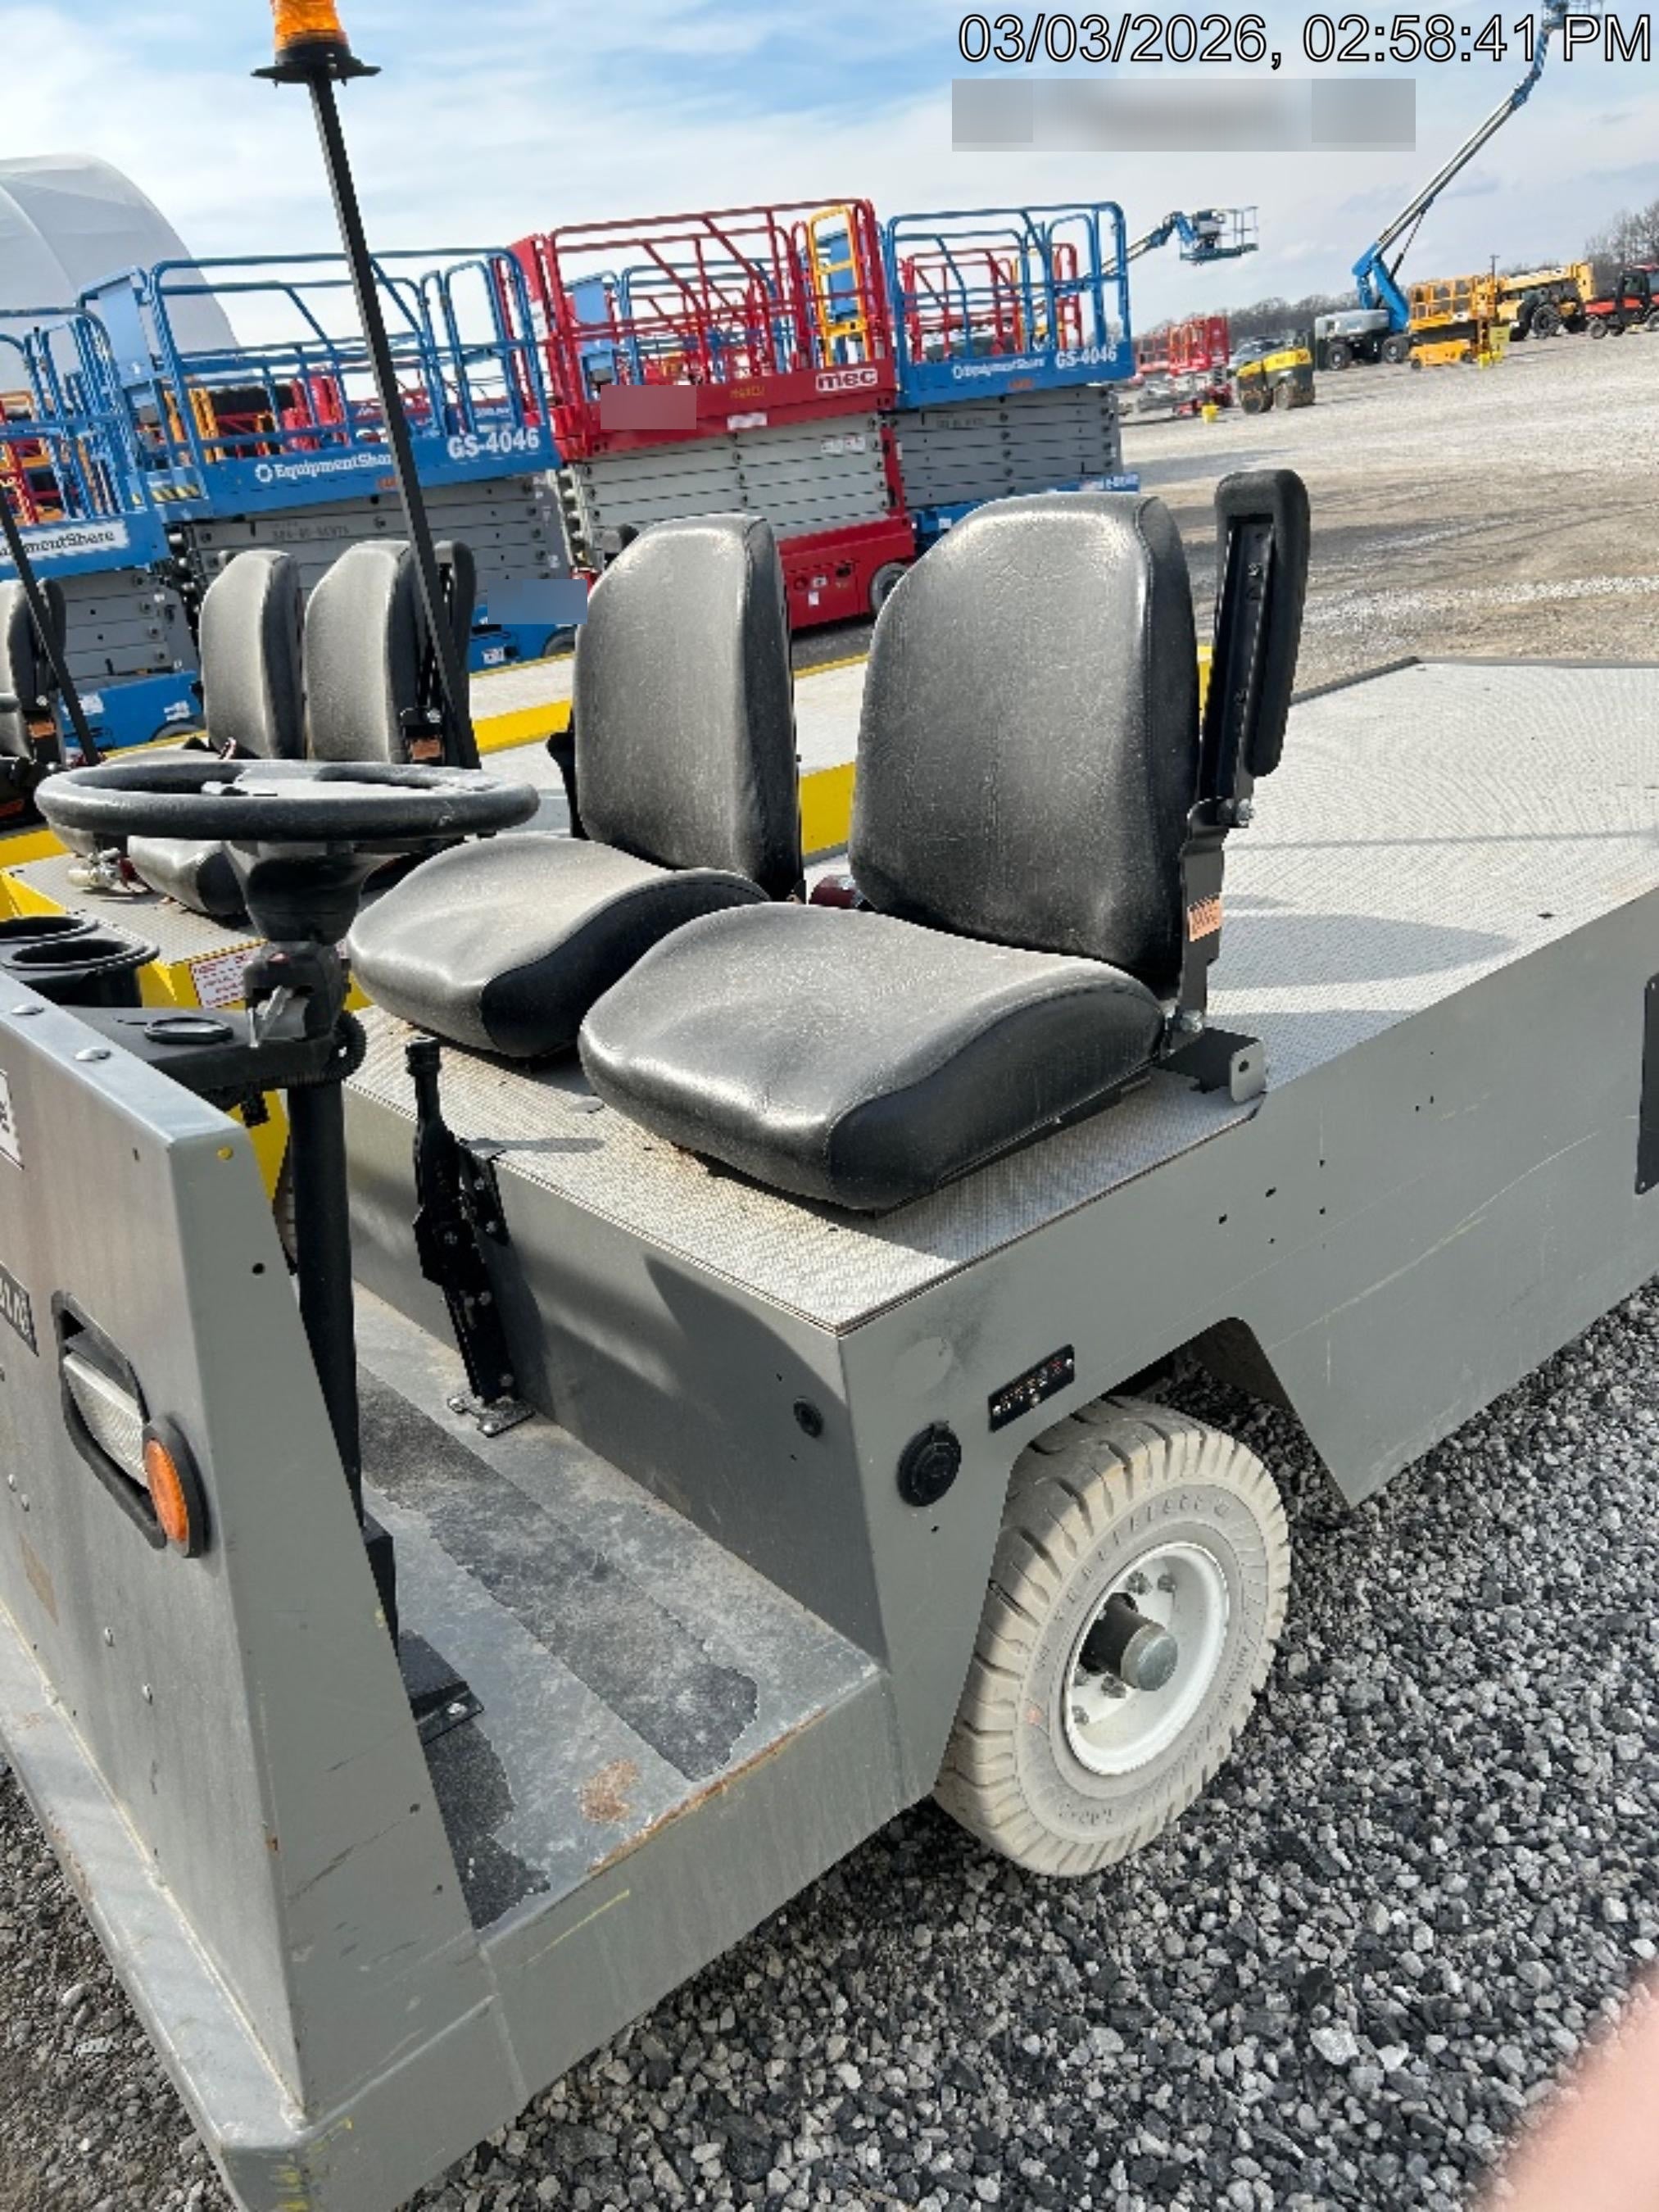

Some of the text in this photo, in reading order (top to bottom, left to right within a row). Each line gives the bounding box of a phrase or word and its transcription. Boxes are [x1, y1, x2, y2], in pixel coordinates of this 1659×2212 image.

[1055, 347, 1117, 369] GS-4046
[446, 427, 540, 460] GS-4046
[272, 452, 392, 480] EquipmentShar
